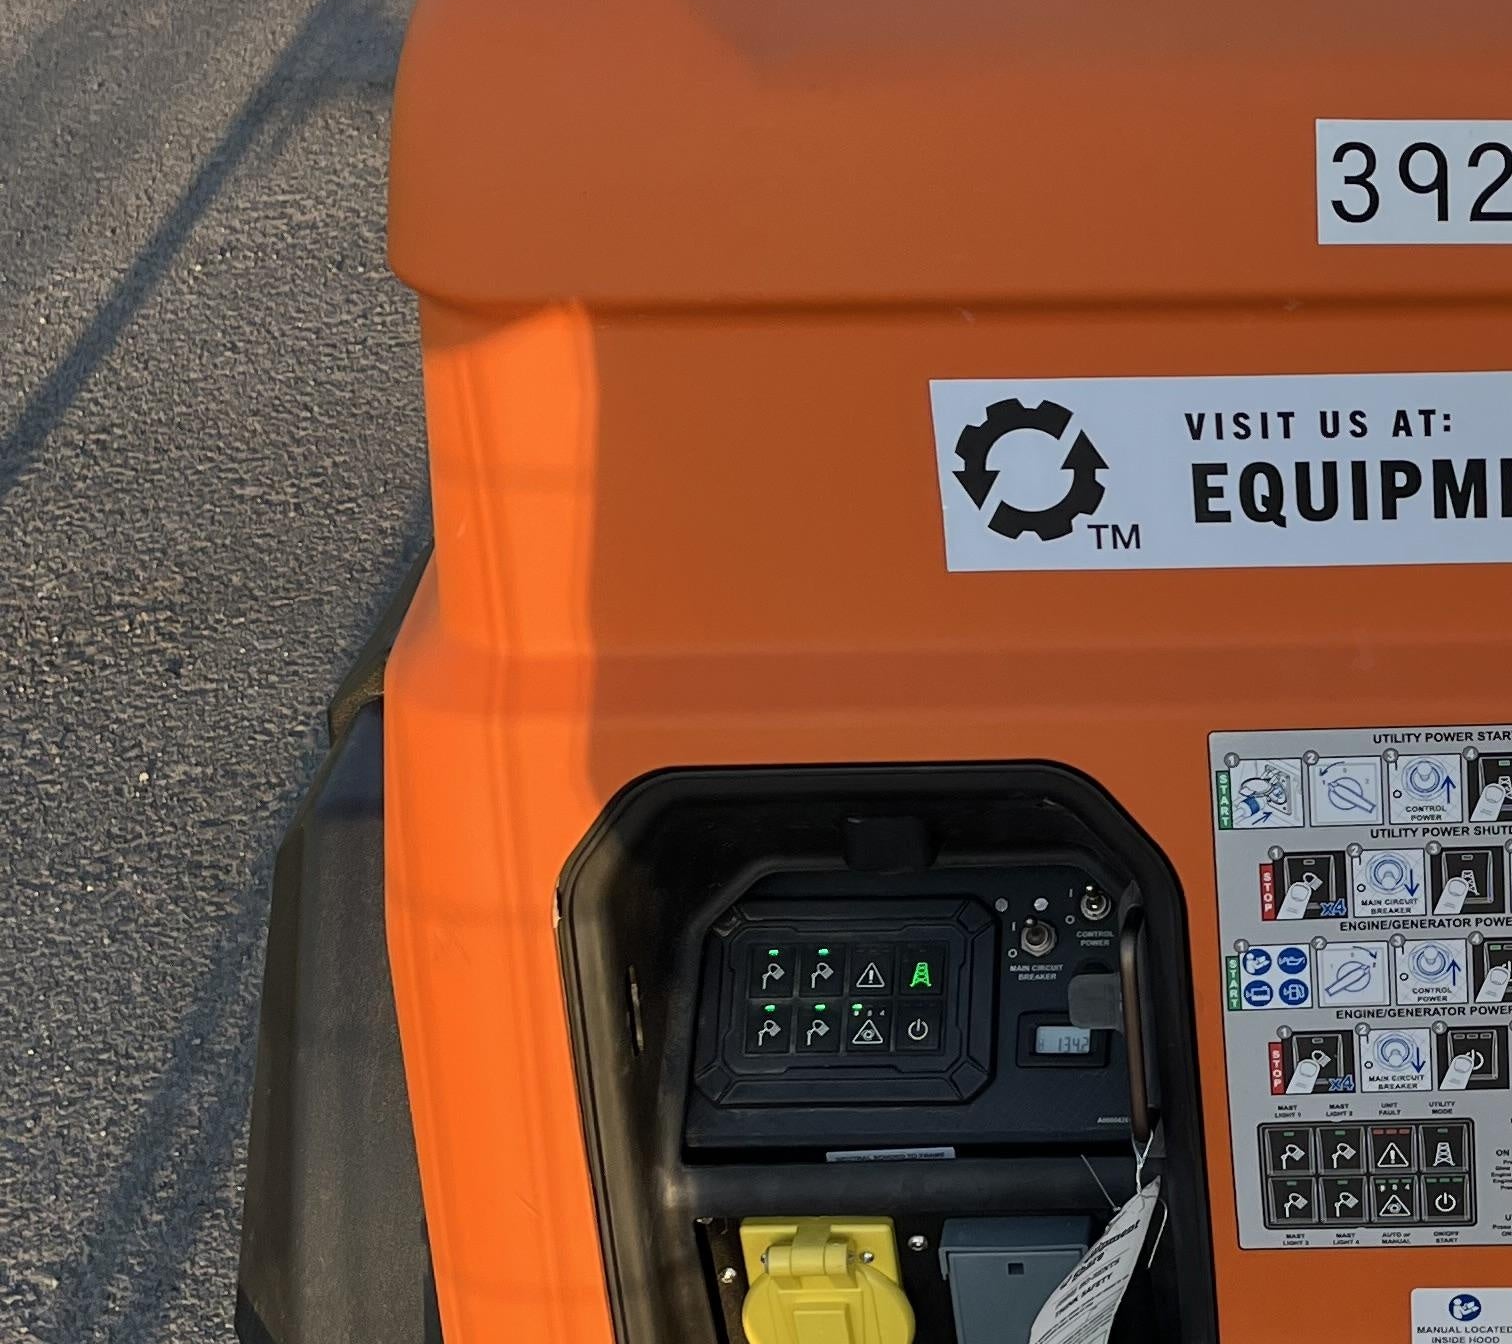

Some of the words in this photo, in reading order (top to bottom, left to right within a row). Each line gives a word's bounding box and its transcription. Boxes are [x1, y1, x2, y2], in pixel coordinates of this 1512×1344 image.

[1185, 411, 1296, 441] VISIT
[1319, 410, 1369, 439] US
[1392, 409, 1452, 438] AT:
[1087, 524, 1141, 550] TM
[1373, 733, 1421, 744] UTILITY
[1426, 731, 1474, 743] POWER
[1219, 774, 1231, 827] START
[1370, 828, 1419, 838] UTILITY
[1422, 826, 1470, 837] POWER
[1263, 873, 1272, 912] STOP
[1320, 898, 1347, 916] x4
[1340, 918, 1472, 932] ENGINE/GENERATOR
[1080, 939, 1110, 947] POWER
[1032, 964, 1063, 972] CIRCUIT
[1018, 973, 1057, 981] BREAKER
[1229, 960, 1239, 1008] START
[1336, 1007, 1466, 1020] ENGINE/GENERATOR
[1272, 1051, 1282, 1087] STOP
[1328, 1075, 1354, 1092] x4
[1417, 1325, 1461, 1334] MANUAL
[1431, 1336, 1466, 1344] INSIDE
[1469, 1336, 1500, 1344] HOOD
